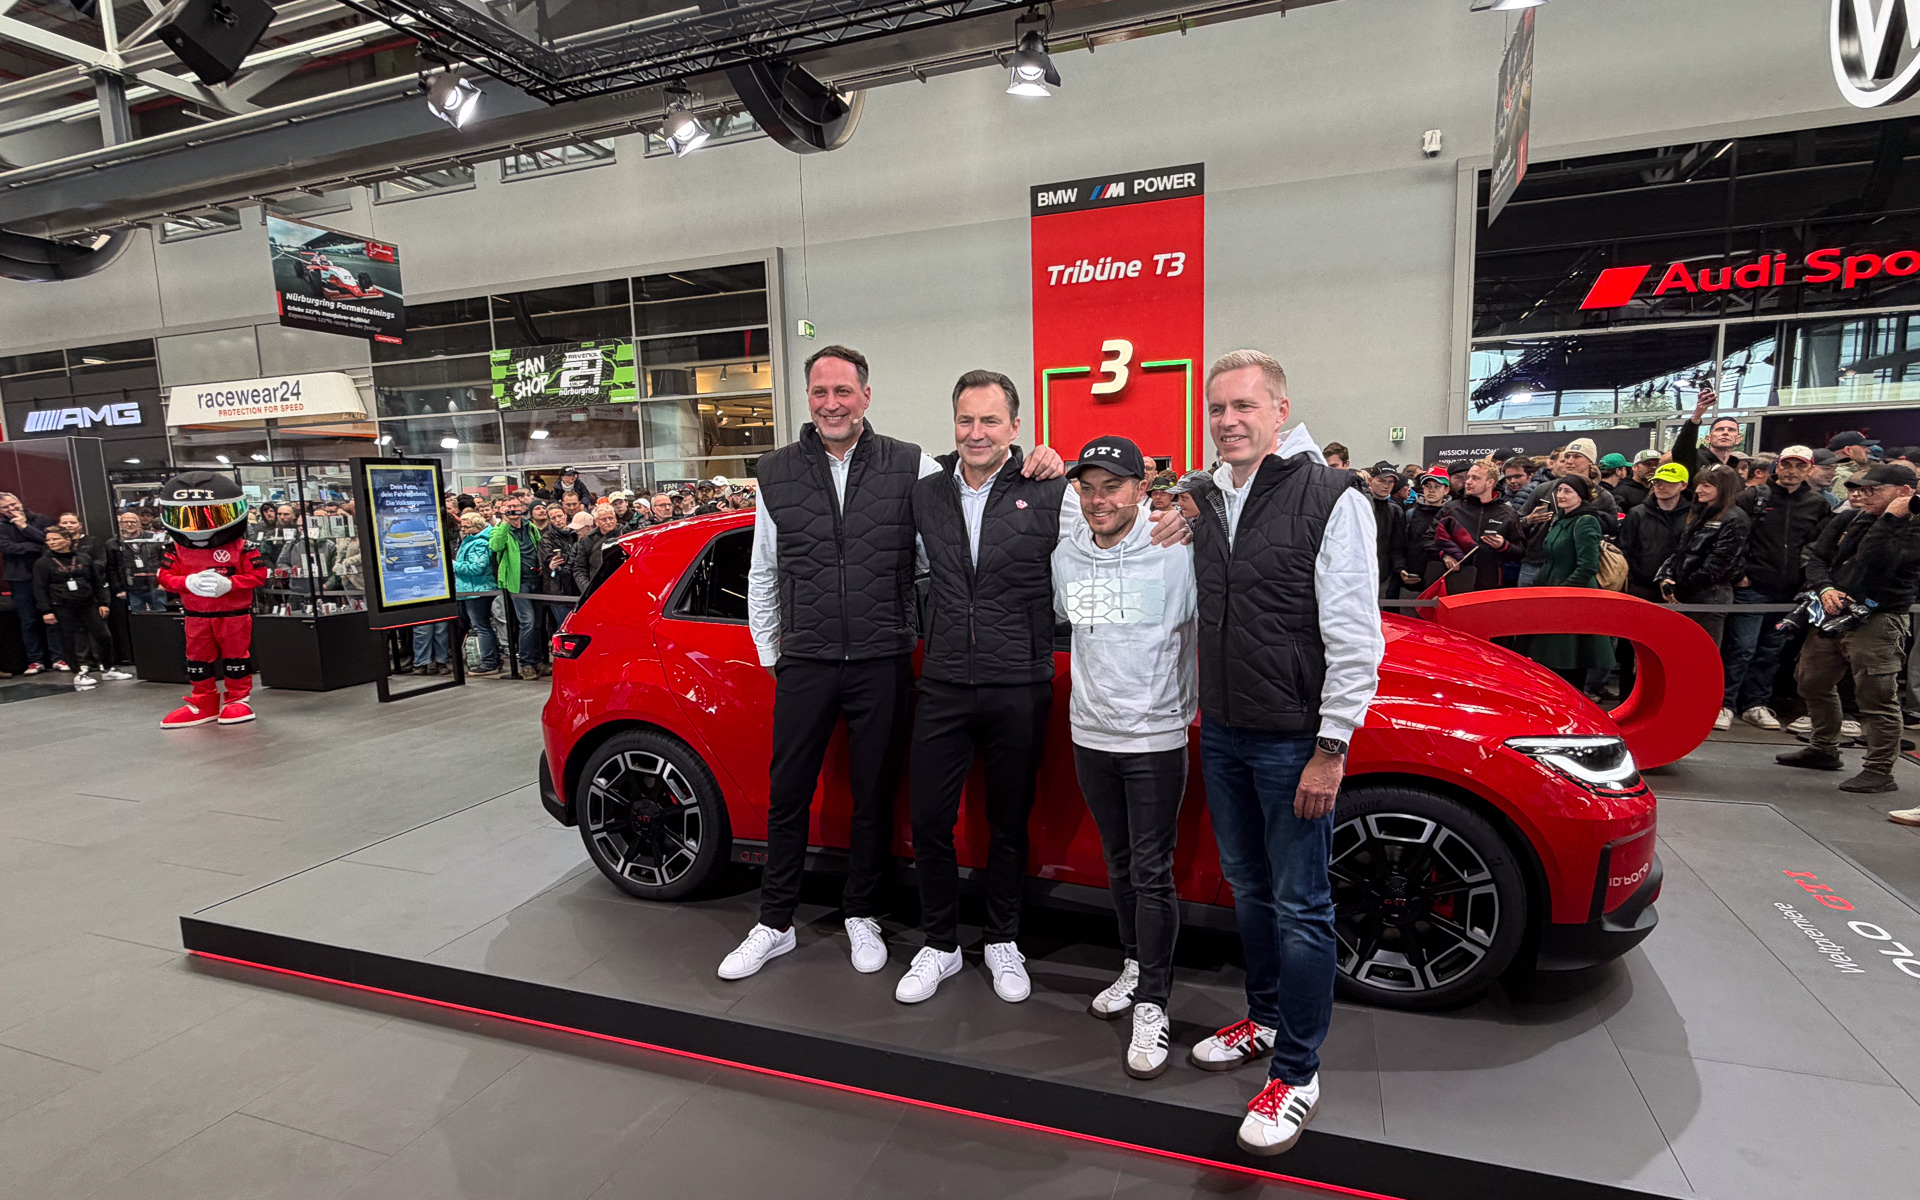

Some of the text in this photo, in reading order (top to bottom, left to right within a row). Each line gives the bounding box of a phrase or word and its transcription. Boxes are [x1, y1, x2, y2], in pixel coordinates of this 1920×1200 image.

[1037, 188, 1078, 207] BMW
[1133, 172, 1196, 194] POWER
[1047, 252, 1186, 286] Tribüne T3
[1653, 248, 1920, 296] Audi Spo
[286, 293, 395, 319] Nürburgring Formeltrainings
[516, 355, 545, 381] FAN
[1090, 339, 1134, 395] 3
[197, 379, 302, 409] racewear24
[513, 375, 549, 400] SHOP
[57, 402, 142, 430] AMG
[218, 403, 304, 417] PROTECTION FOR SPEED
[1083, 446, 1122, 459] GTI
[1439, 447, 1524, 457] MISSION ACCOMED
[173, 488, 215, 500] GTI
[663, 483, 679, 491] FAN
[1774, 901, 1866, 974] Weltpremiere
[1782, 869, 1920, 983] OLO GTI
